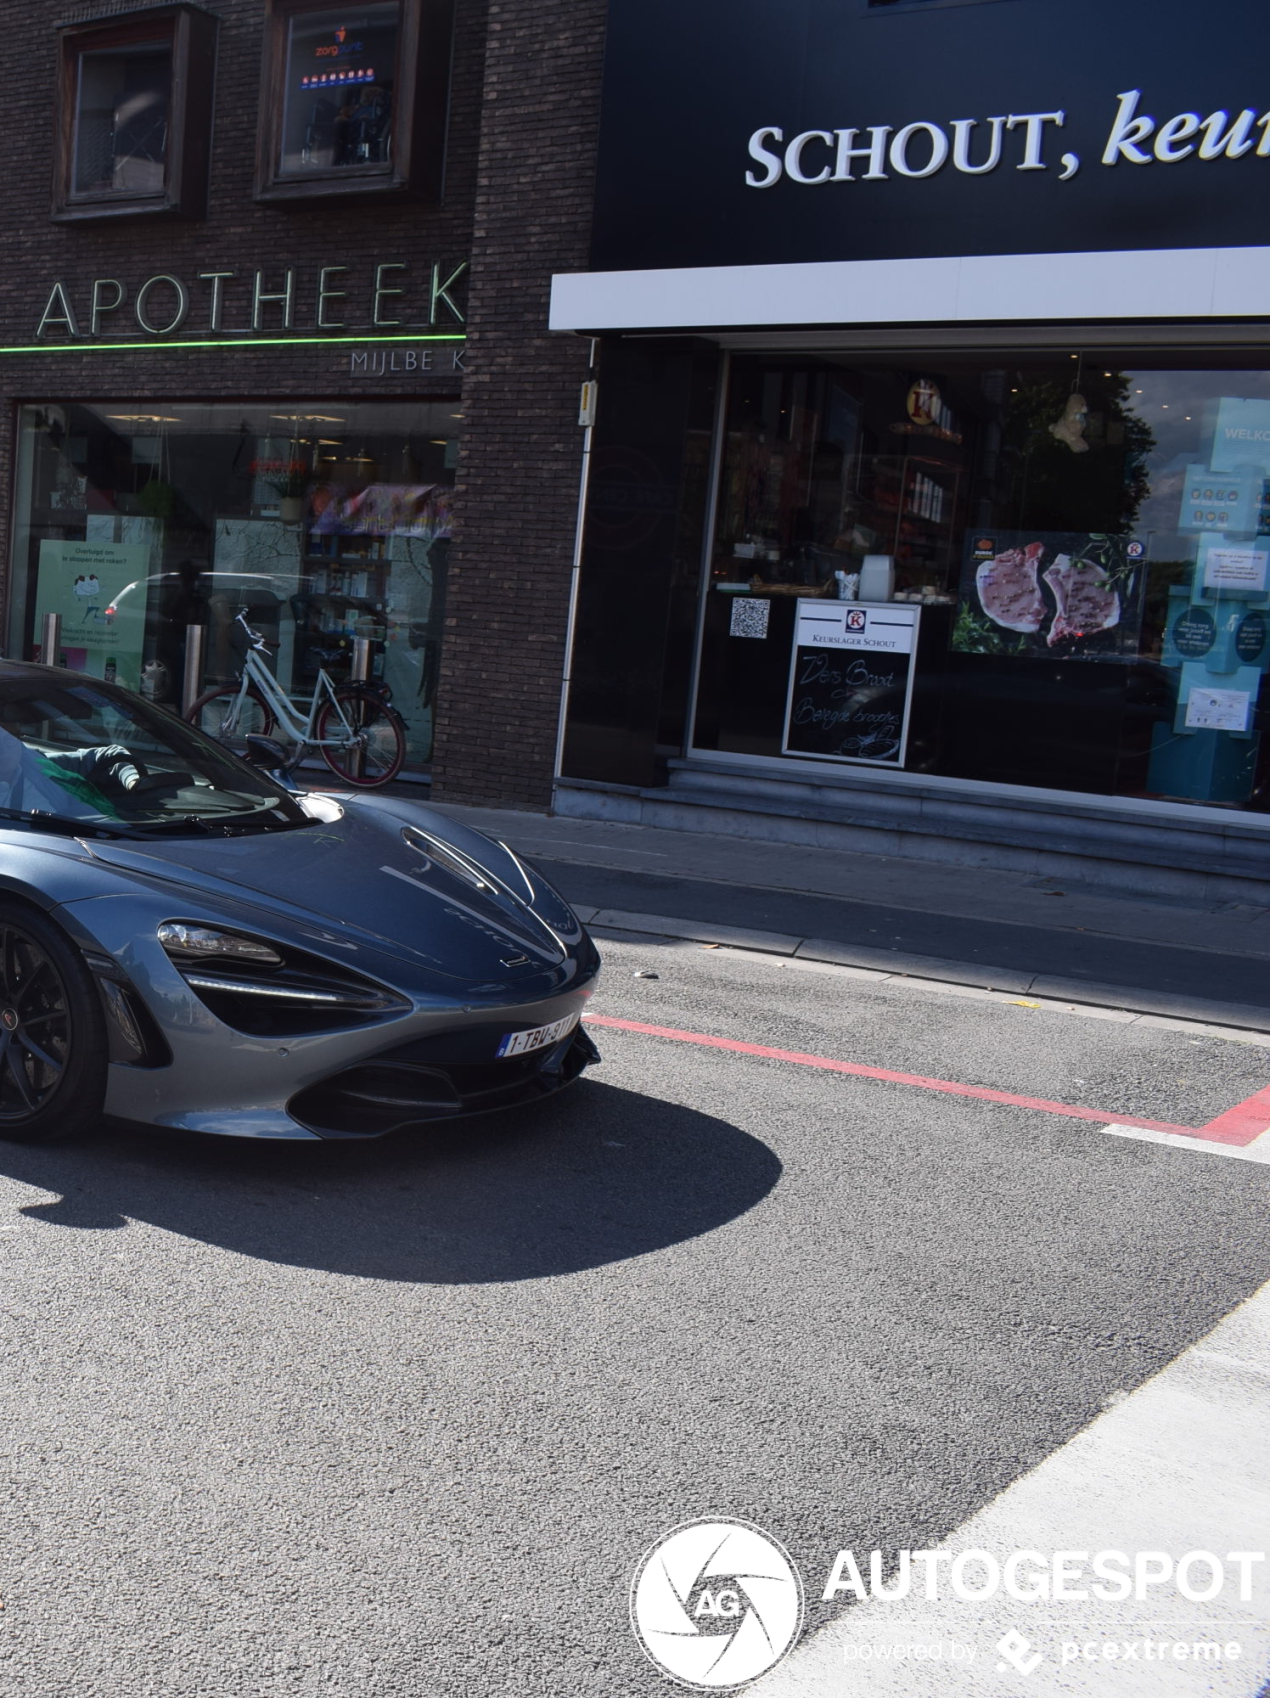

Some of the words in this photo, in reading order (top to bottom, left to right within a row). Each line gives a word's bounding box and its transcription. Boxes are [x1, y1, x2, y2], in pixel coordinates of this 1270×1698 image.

[745, 110, 1079, 188] SCHOUT,
[35, 259, 468, 337] APOTHEEK
[812, 634, 861, 646] KEURSLAGER
[863, 638, 897, 648] SCHOUT
